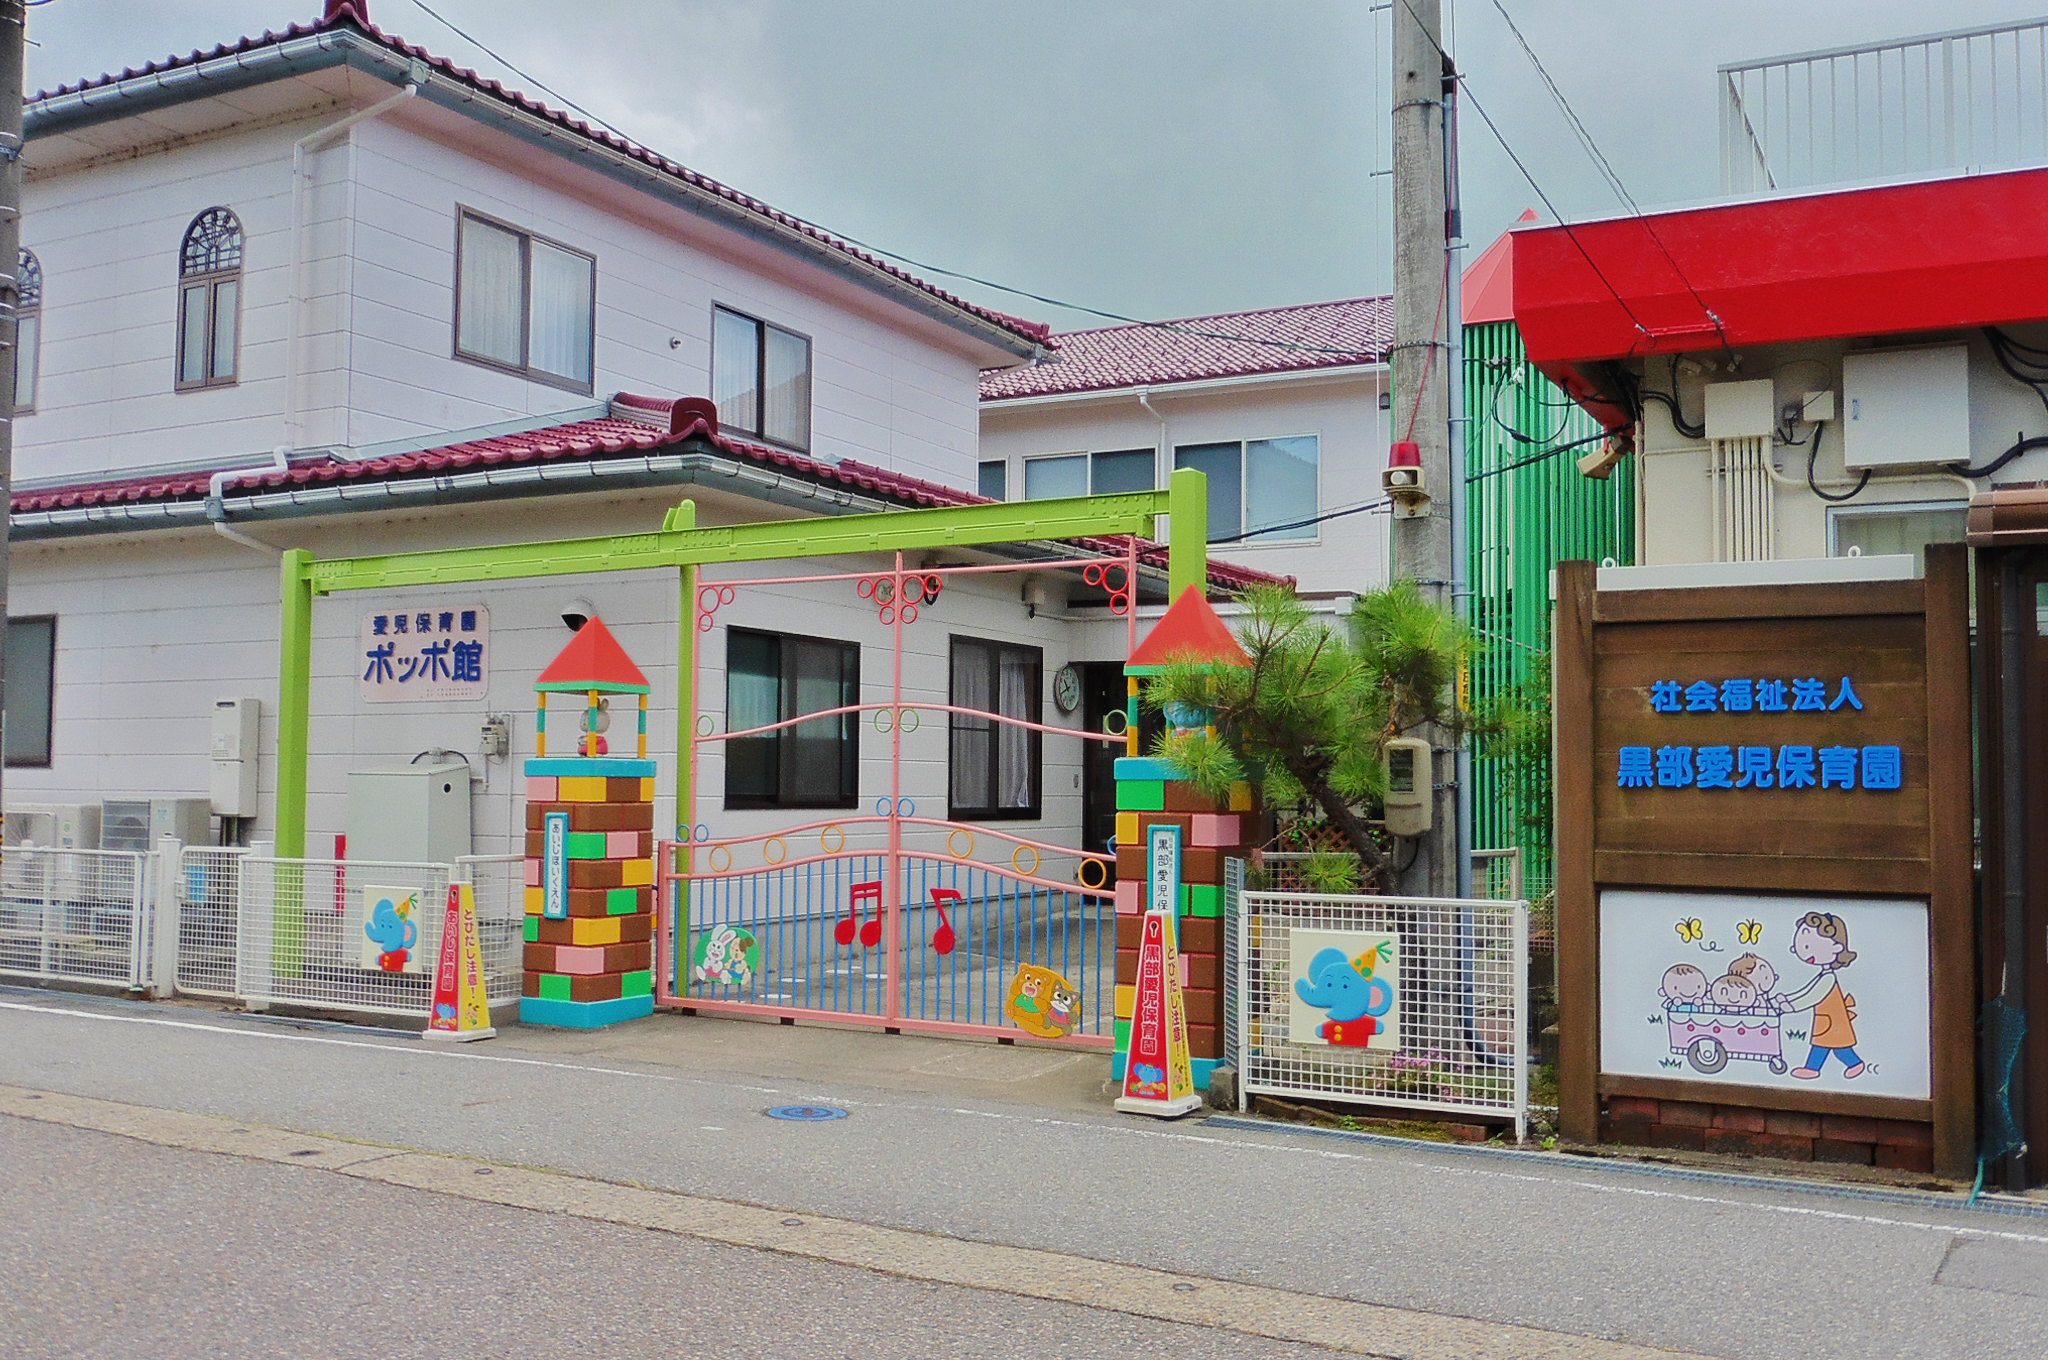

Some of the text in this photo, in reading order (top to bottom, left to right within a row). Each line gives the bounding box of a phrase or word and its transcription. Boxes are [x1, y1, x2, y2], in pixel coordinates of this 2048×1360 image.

[373, 611, 477, 635] 愛児保育園
[363, 638, 483, 684] ポッポ館
[1650, 676, 1863, 713] 社会福祉法人
[1617, 744, 1901, 789] 黒部愛児保育園
[551, 823, 561, 909] あいじほいくえん
[1141, 945, 1160, 1054] 黒部愛児保育園
